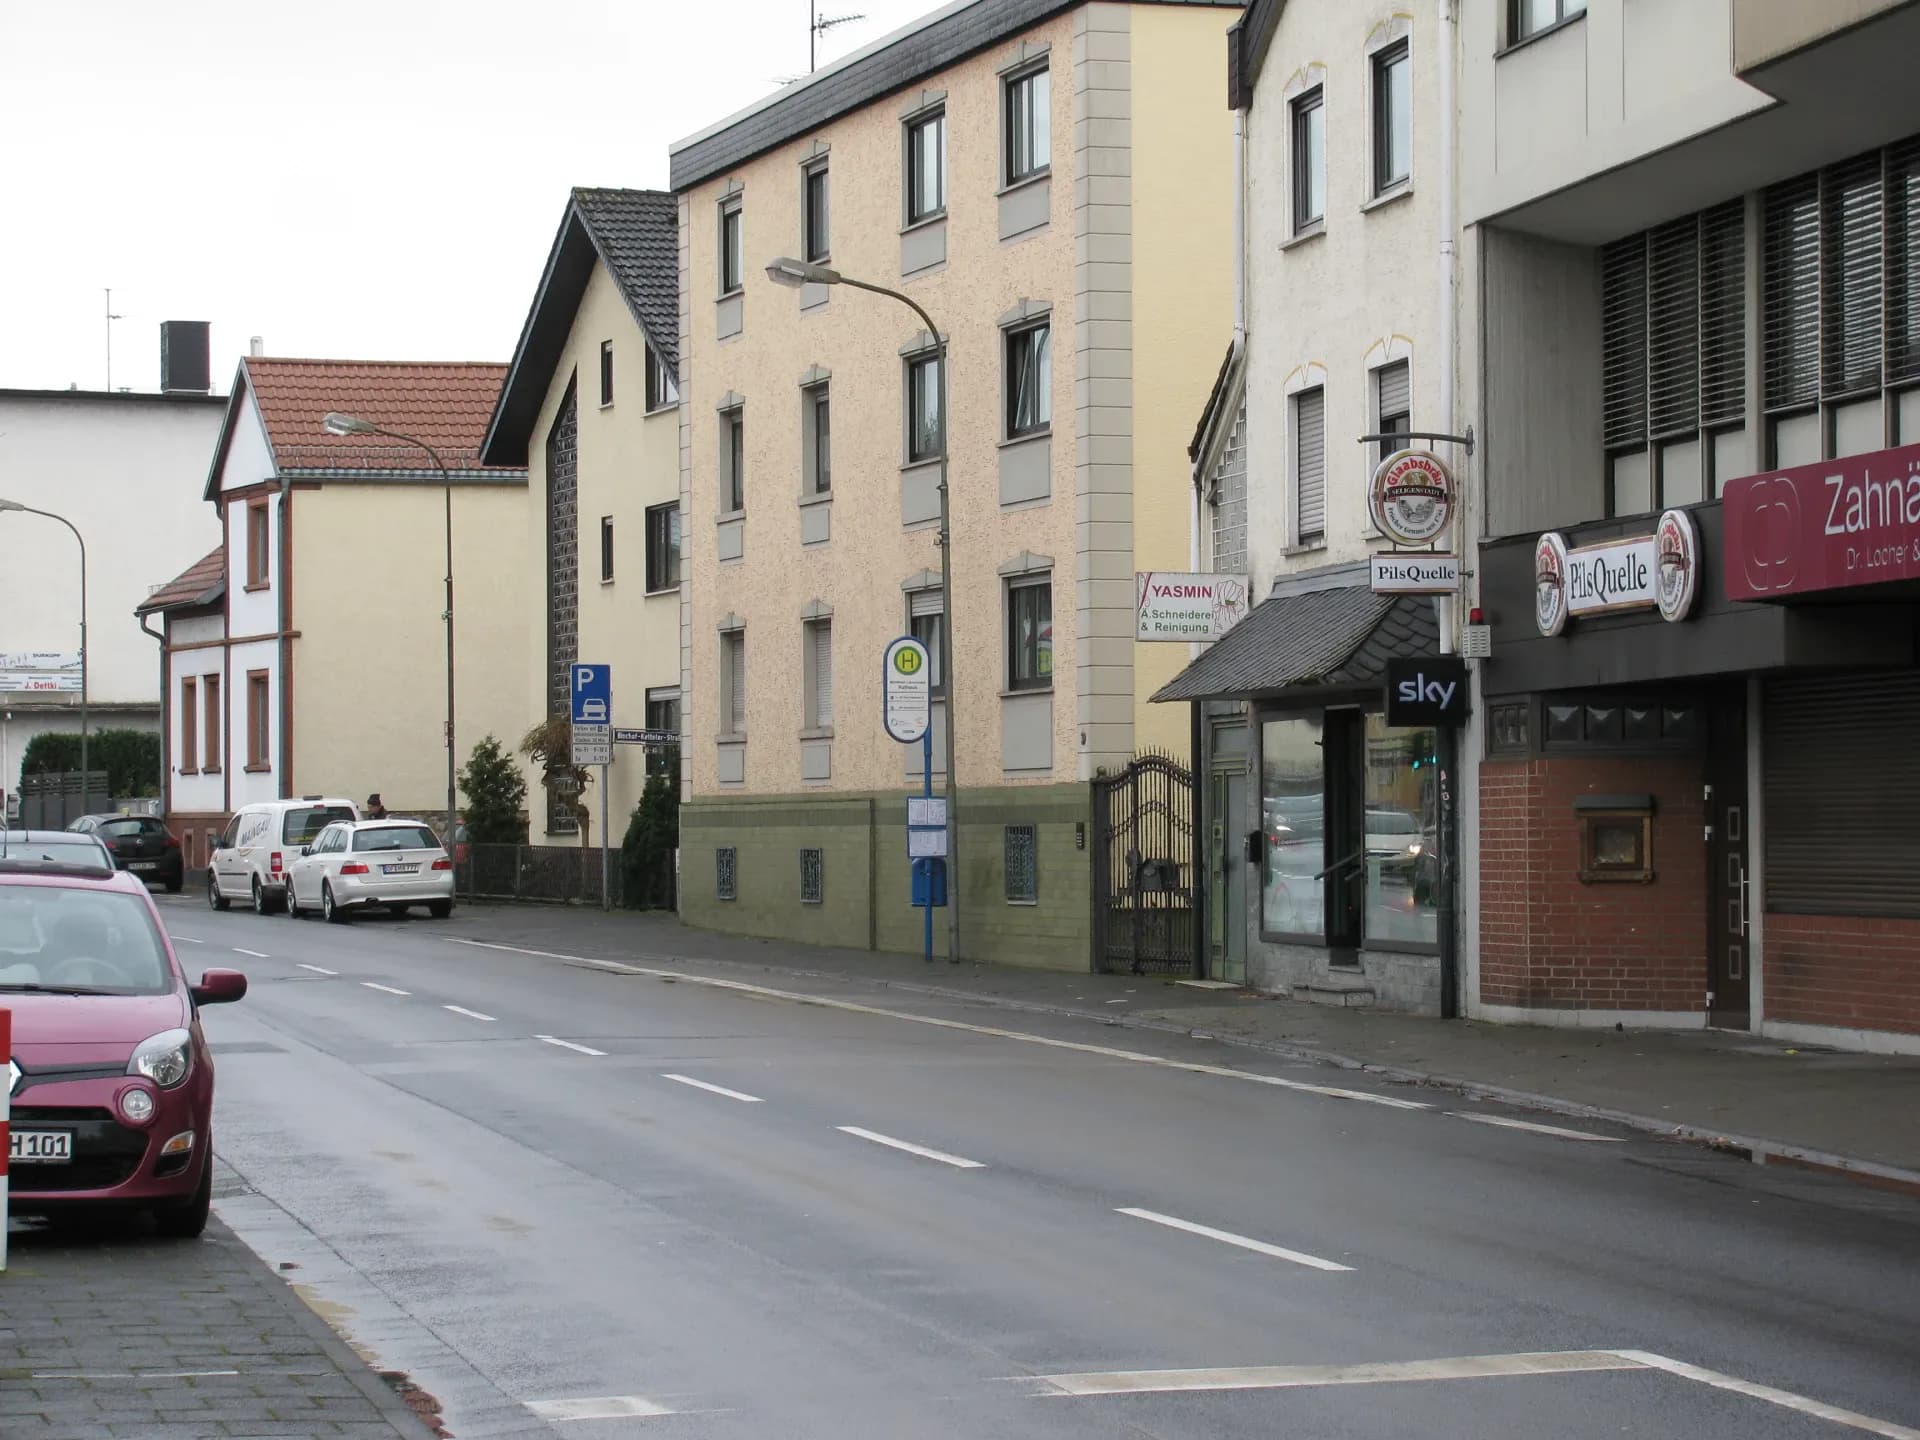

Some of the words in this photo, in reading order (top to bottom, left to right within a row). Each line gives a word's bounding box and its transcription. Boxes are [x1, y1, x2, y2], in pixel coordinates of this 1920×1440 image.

[1387, 457, 1442, 486] Glaabsbräu
[1847, 547, 1863, 570] Dr.
[1867, 544, 1909, 568] Locher
[1912, 538, 1920, 561] &
[1378, 565, 1455, 583] PilsQuelle
[1569, 552, 1648, 603] PilsQuelle
[1152, 585, 1212, 598] YASMIN
[1140, 623, 1148, 631] &
[1155, 622, 1209, 634] Reinigung
[902, 653, 914, 669] H
[577, 668, 594, 692] P
[1399, 673, 1457, 710] sky
[27, 1134, 68, 1157] 101
